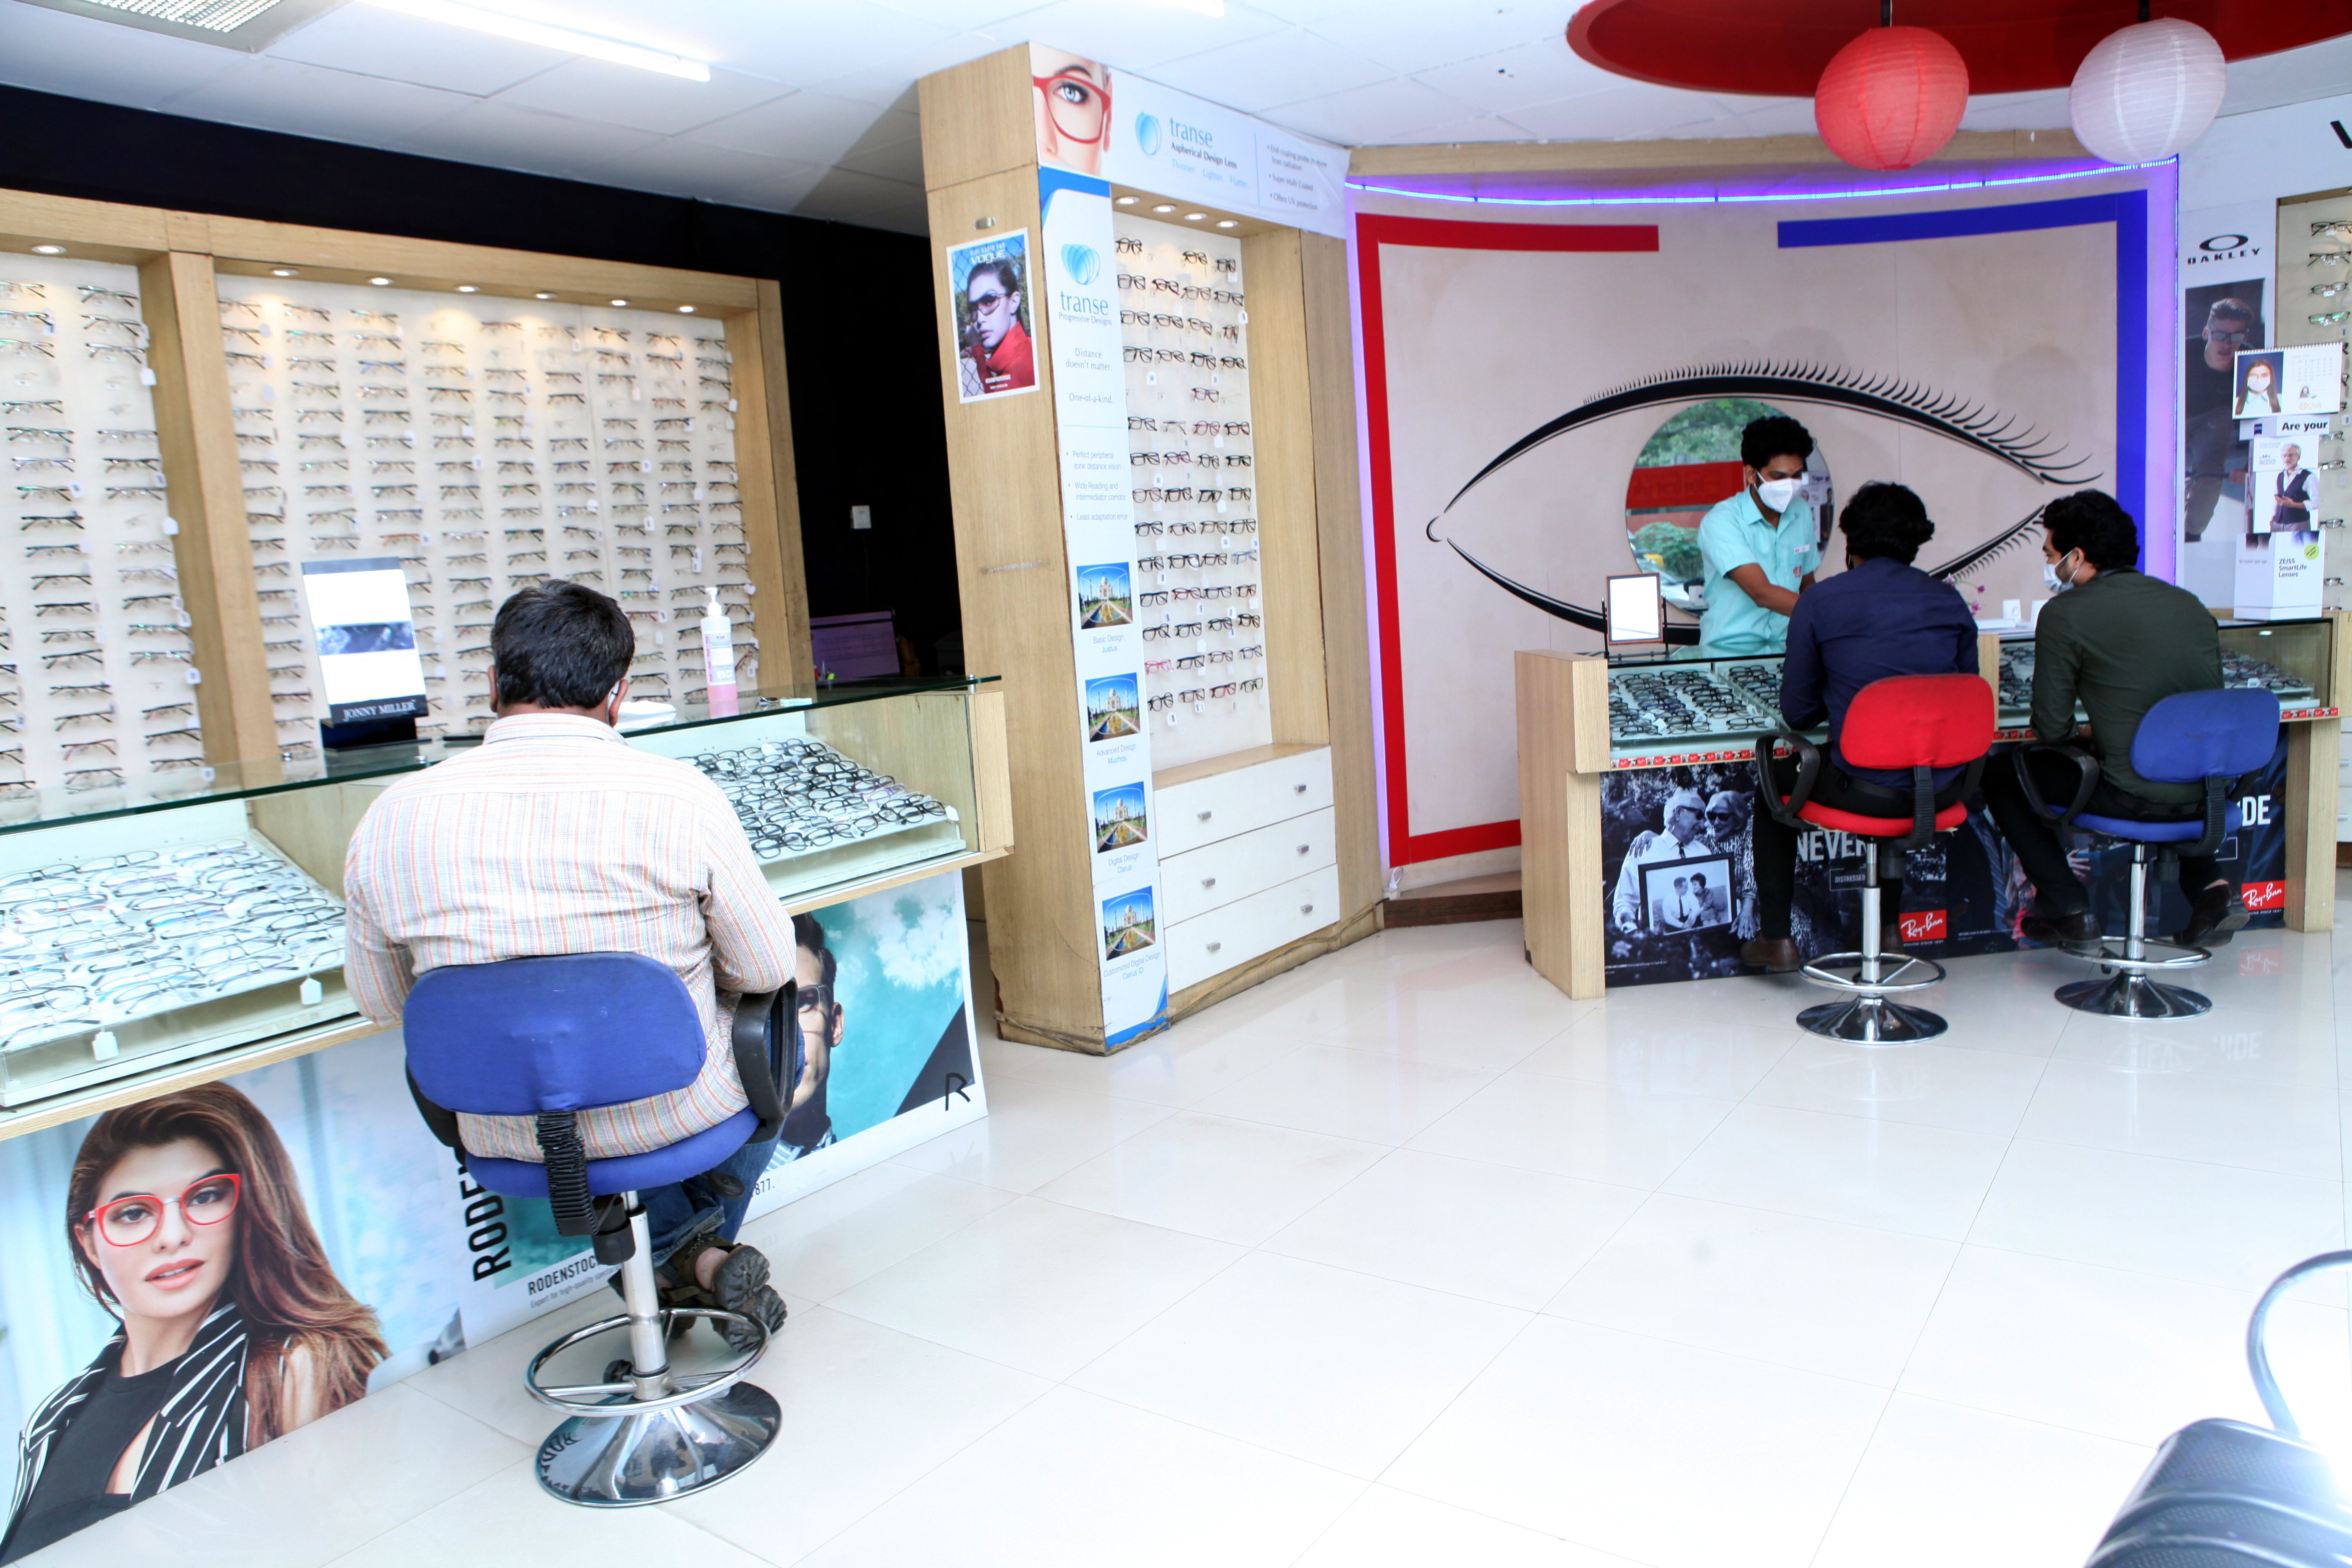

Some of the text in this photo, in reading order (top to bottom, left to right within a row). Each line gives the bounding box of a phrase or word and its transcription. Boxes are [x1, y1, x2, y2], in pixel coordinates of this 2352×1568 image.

[1170, 117, 1213, 148] transe
[1171, 141, 1238, 169] Aspherical Design Lens
[2187, 248, 2261, 265] OAKLEY
[1060, 291, 1109, 316] transe
[1059, 312, 1112, 327] Progressive Designs
[1075, 348, 1102, 358] Distance
[1066, 358, 1112, 371] doesn't matter.
[1069, 392, 1114, 404] One-of-a-kind.
[2282, 421, 2328, 433] Are your
[1088, 482, 1108, 491] Reading
[1091, 513, 1116, 521] adaptation
[342, 705, 377, 722] JONNY
[1096, 746, 1119, 756] Advanced
[1108, 756, 1127, 764] Muchos
[2236, 794, 2271, 827] DE
[1109, 853, 1140, 866] Digital Design
[1117, 865, 1132, 873] Clarus
[1835, 874, 1866, 883] DISTRESSED
[2242, 882, 2282, 908] Ray-Ban
[1901, 912, 1943, 938] Ray-Ban
[1103, 952, 1161, 977] Customized Digital Design
[1122, 970, 1137, 980] Clarus
[945, 1072, 971, 1112] R
[457, 1164, 512, 1281] RODE
[528, 1255, 599, 1296] RODENSTOC
[530, 1295, 549, 1308] Expert
[560, 1277, 594, 1295] high-quality
